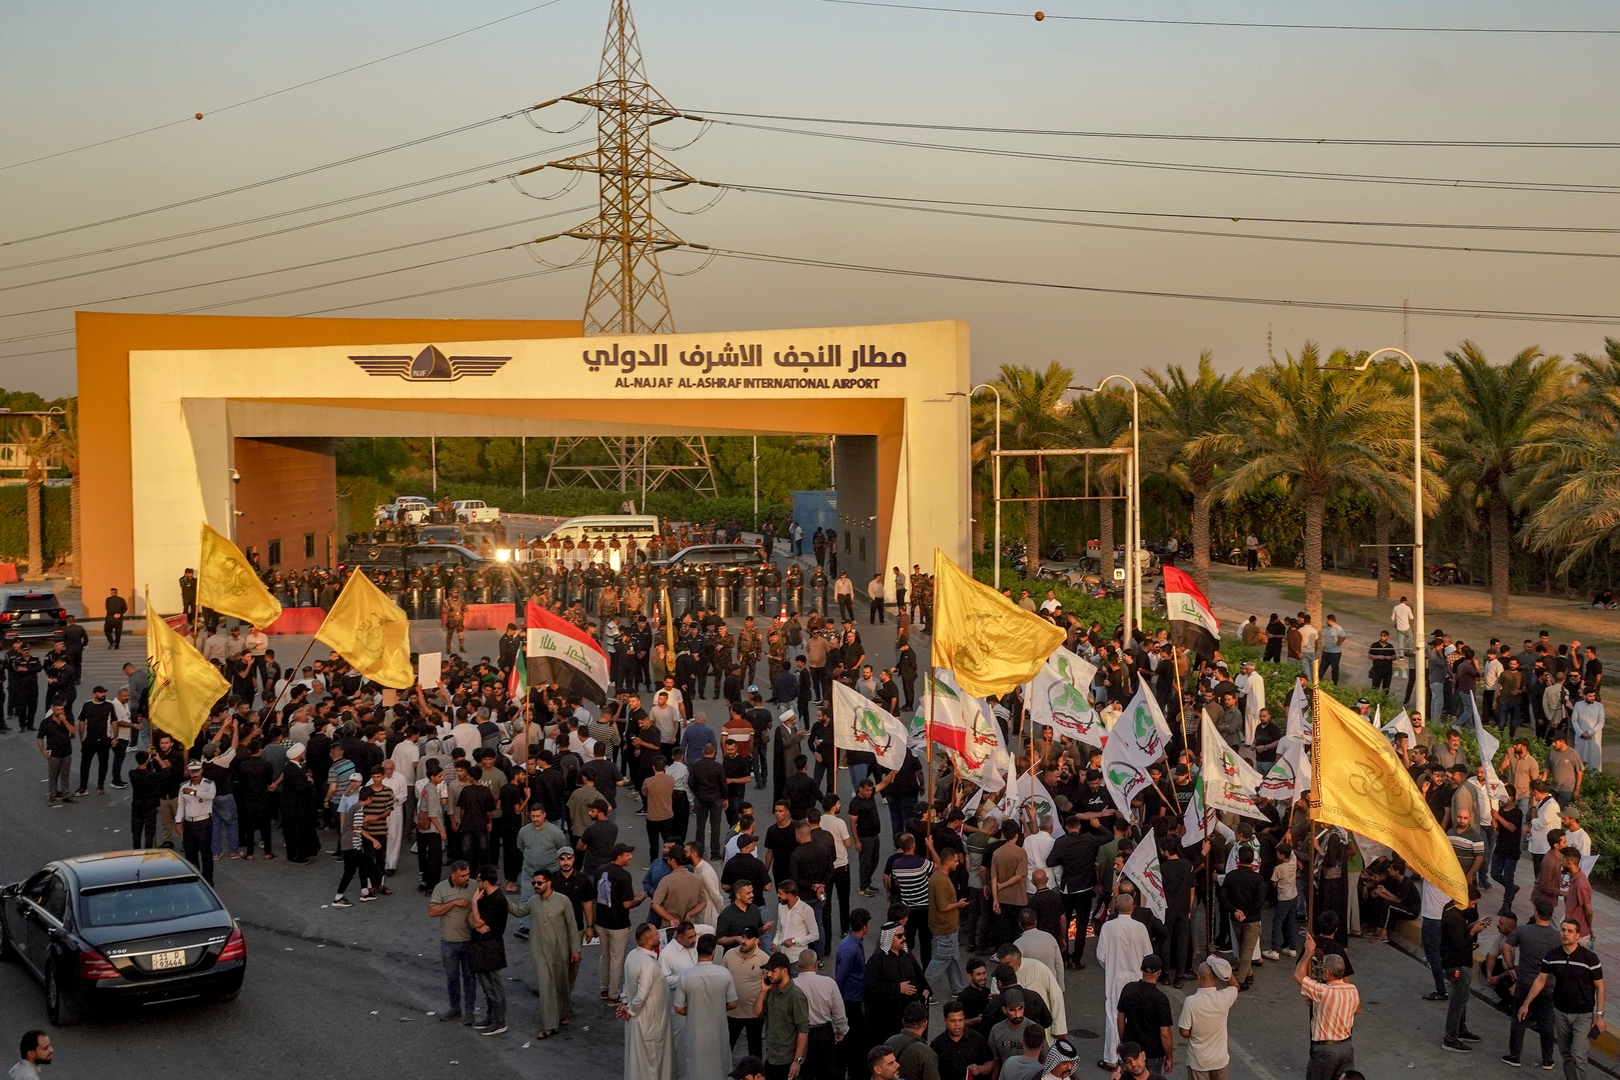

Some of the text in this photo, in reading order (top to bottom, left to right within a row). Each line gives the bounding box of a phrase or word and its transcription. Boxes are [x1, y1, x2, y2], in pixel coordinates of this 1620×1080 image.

[583, 342, 907, 374] مطار النجف الاشرف الدولي
[615, 377, 880, 389] AL-NAJAF AL-ASHRAF INTERNATIONAL AIRPORT
[159, 953, 168, 961] 11
